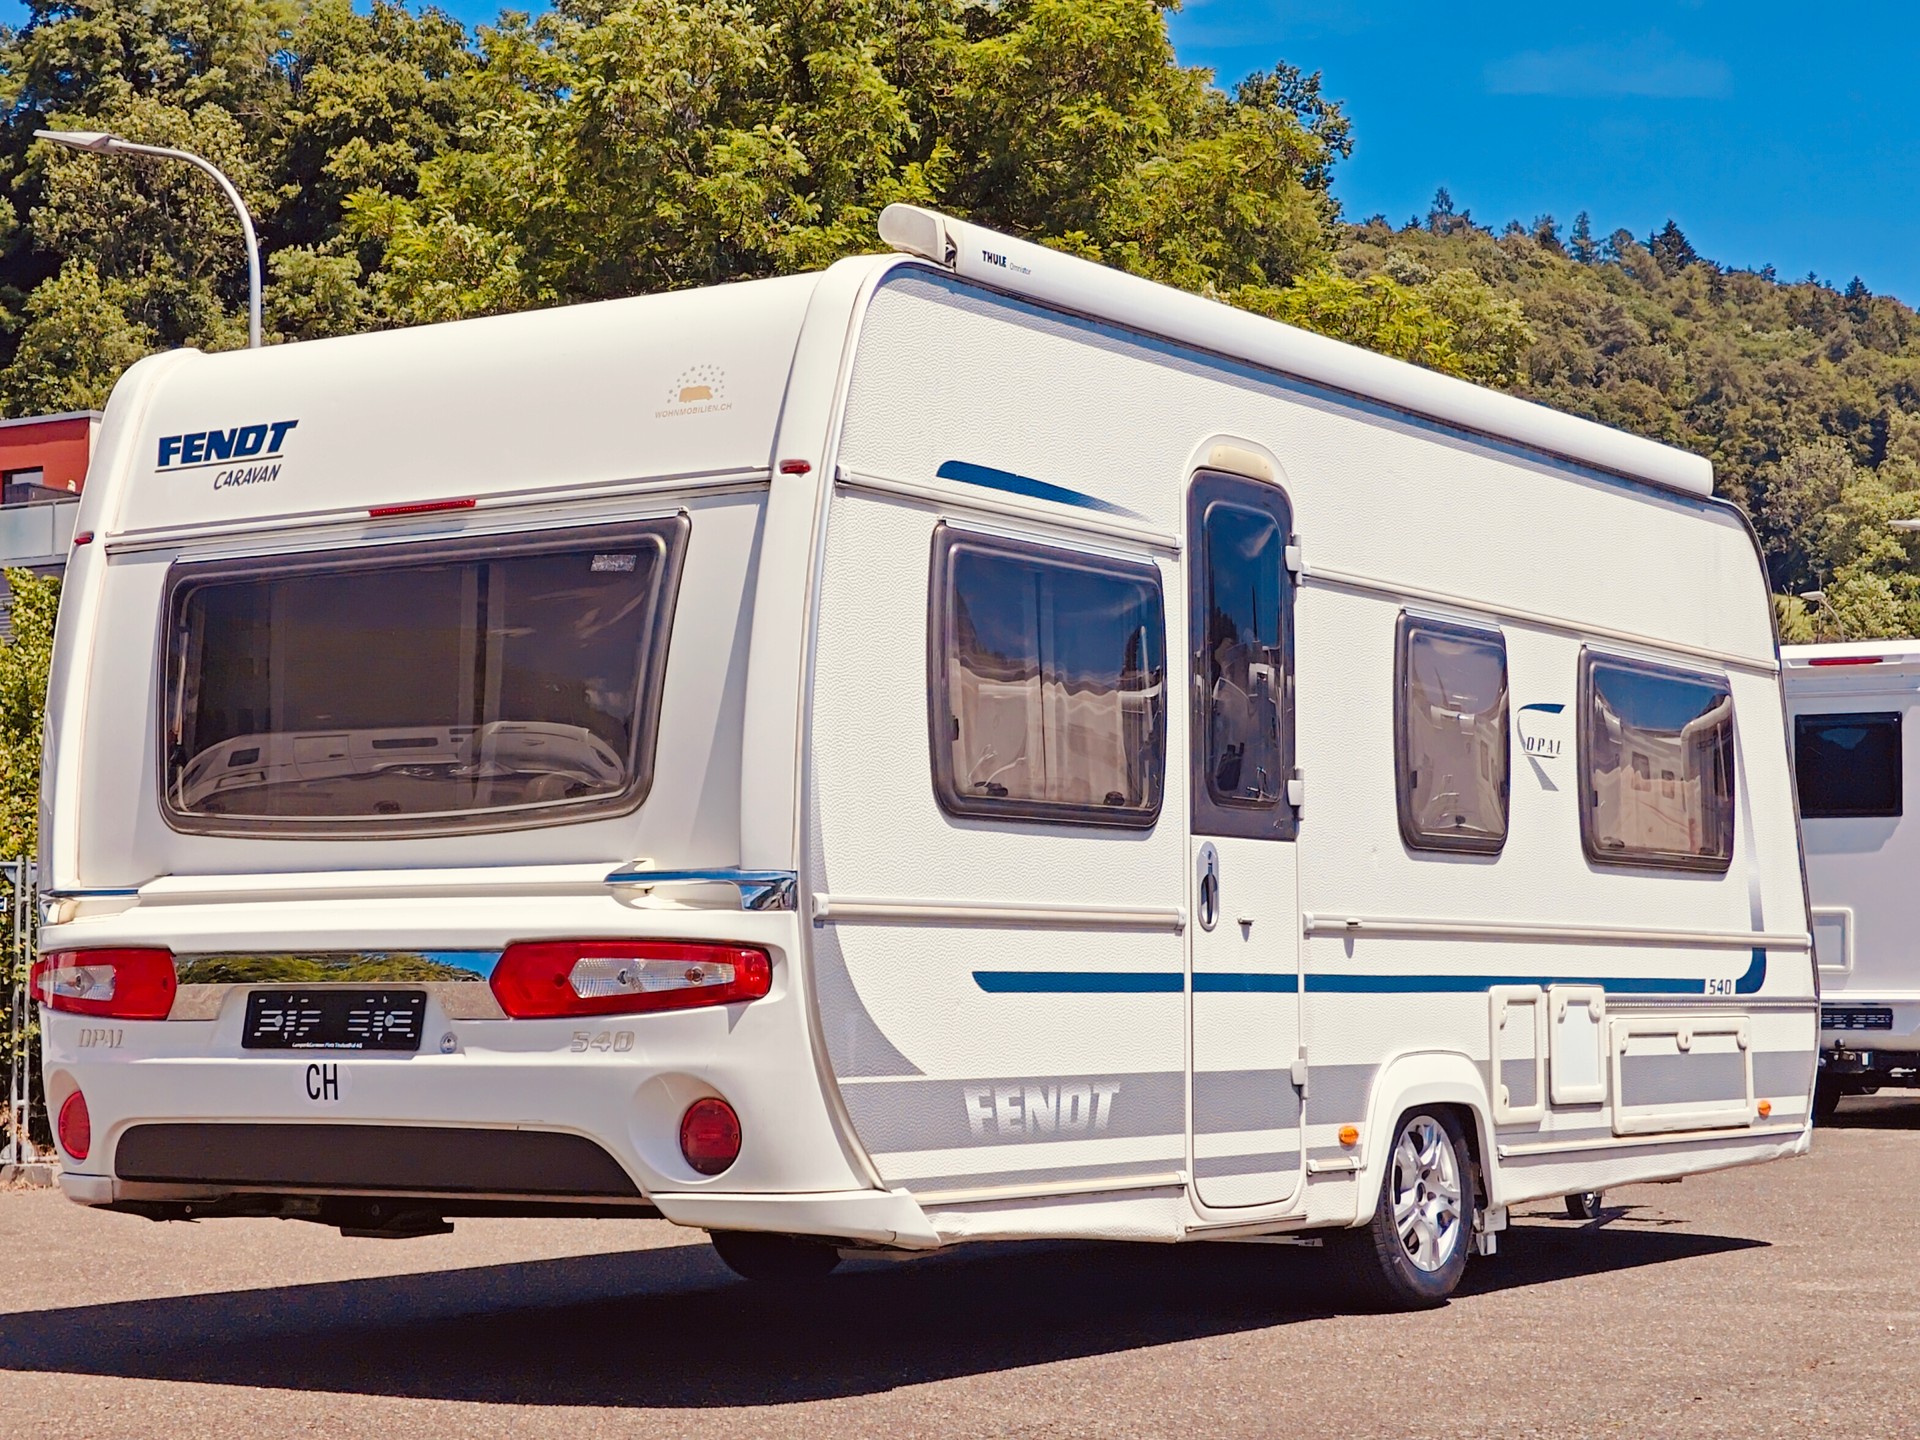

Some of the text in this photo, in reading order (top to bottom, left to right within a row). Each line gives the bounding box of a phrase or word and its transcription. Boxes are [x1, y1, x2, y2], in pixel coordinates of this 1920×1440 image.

[982, 250, 1007, 268] THULE
[654, 403, 732, 418] WOHNMOBILIEN.CH
[157, 419, 299, 467] FENDT
[213, 463, 282, 490] CARAVAN
[1526, 736, 1561, 754] OPAL
[1709, 979, 1732, 995] 540
[570, 1031, 635, 1053] 540
[306, 1063, 338, 1100] CH
[964, 1081, 1121, 1137] FENDT
